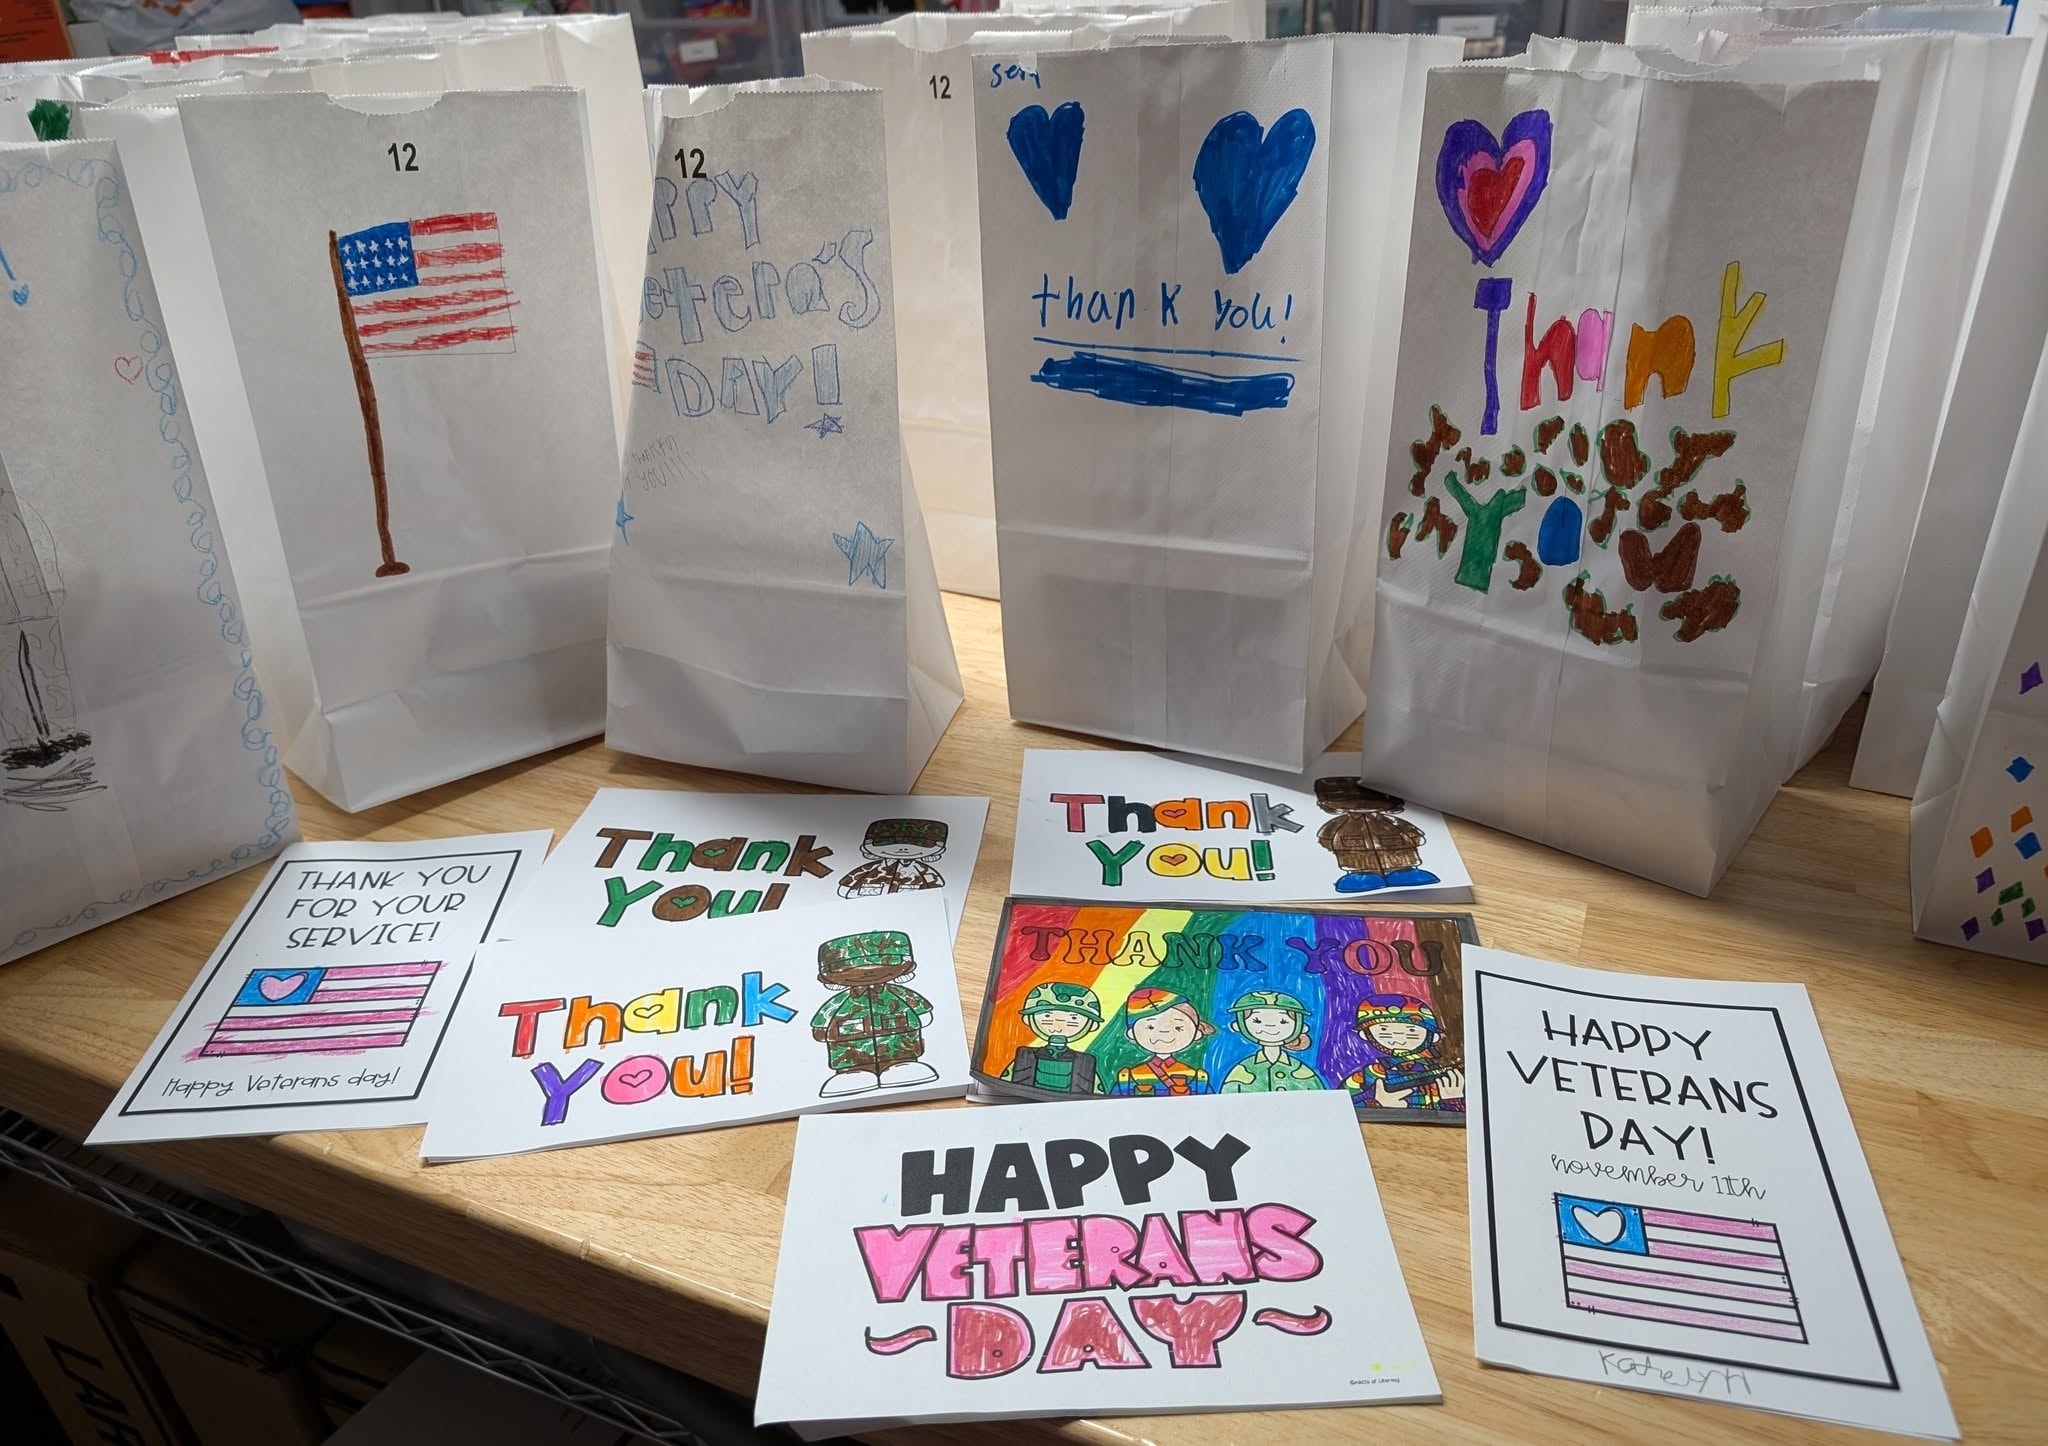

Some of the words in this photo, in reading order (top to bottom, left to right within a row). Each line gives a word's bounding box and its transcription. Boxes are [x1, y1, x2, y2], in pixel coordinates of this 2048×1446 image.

[929, 74, 952, 99] 12
[387, 142, 420, 172] 12
[673, 147, 708, 178] 12
[646, 169, 760, 255] PPY
[1050, 793, 1305, 834] Thank
[298, 869, 405, 891] THANK
[417, 864, 492, 888] YOU
[594, 827, 834, 878] Thank
[286, 897, 357, 919] FOR
[372, 893, 466, 917] YOUR
[286, 921, 441, 949] SERVICE!
[1020, 924, 1268, 973] THANK
[1284, 935, 1445, 978] YOU
[498, 970, 799, 1062] Thank
[1541, 1009, 1713, 1062] HAPPY
[161, 1077, 234, 1099] Happy
[246, 1073, 341, 1093] Veterans
[347, 1066, 401, 1088] day!
[1506, 1049, 1780, 1120] VETERANS
[1579, 1109, 1717, 1165] DAY!
[900, 1132, 1251, 1217] HAPPY
[1551, 1153, 1704, 1192] november
[853, 1202, 1325, 1304] VETERANS
[945, 1291, 1248, 1380] DAY
